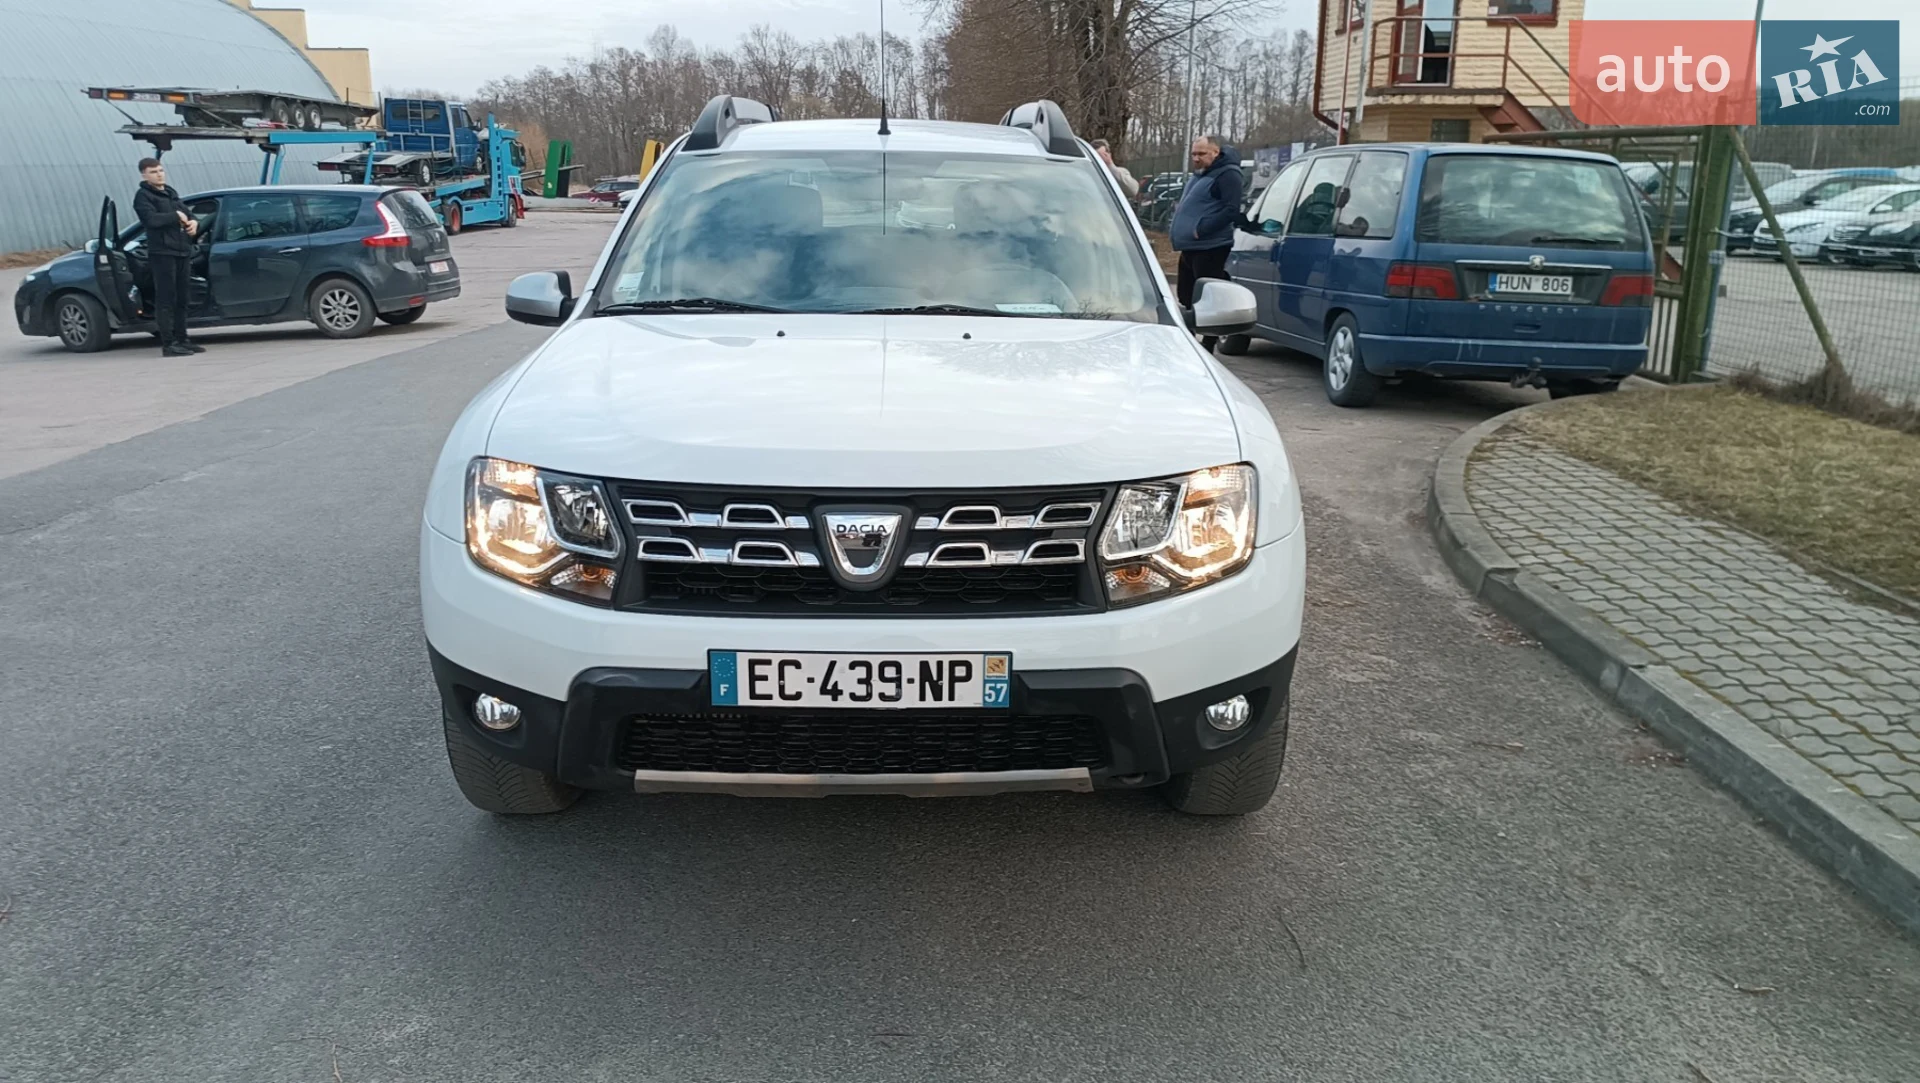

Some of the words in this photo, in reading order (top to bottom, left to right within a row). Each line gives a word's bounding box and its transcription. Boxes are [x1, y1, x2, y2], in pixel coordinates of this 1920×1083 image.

[1498, 276, 1532, 291] HUN
[1541, 277, 1570, 293] 806
[836, 524, 887, 533] DACIA
[747, 658, 973, 702] EC-439-NP
[720, 684, 730, 696] F
[984, 683, 1008, 703] 57
